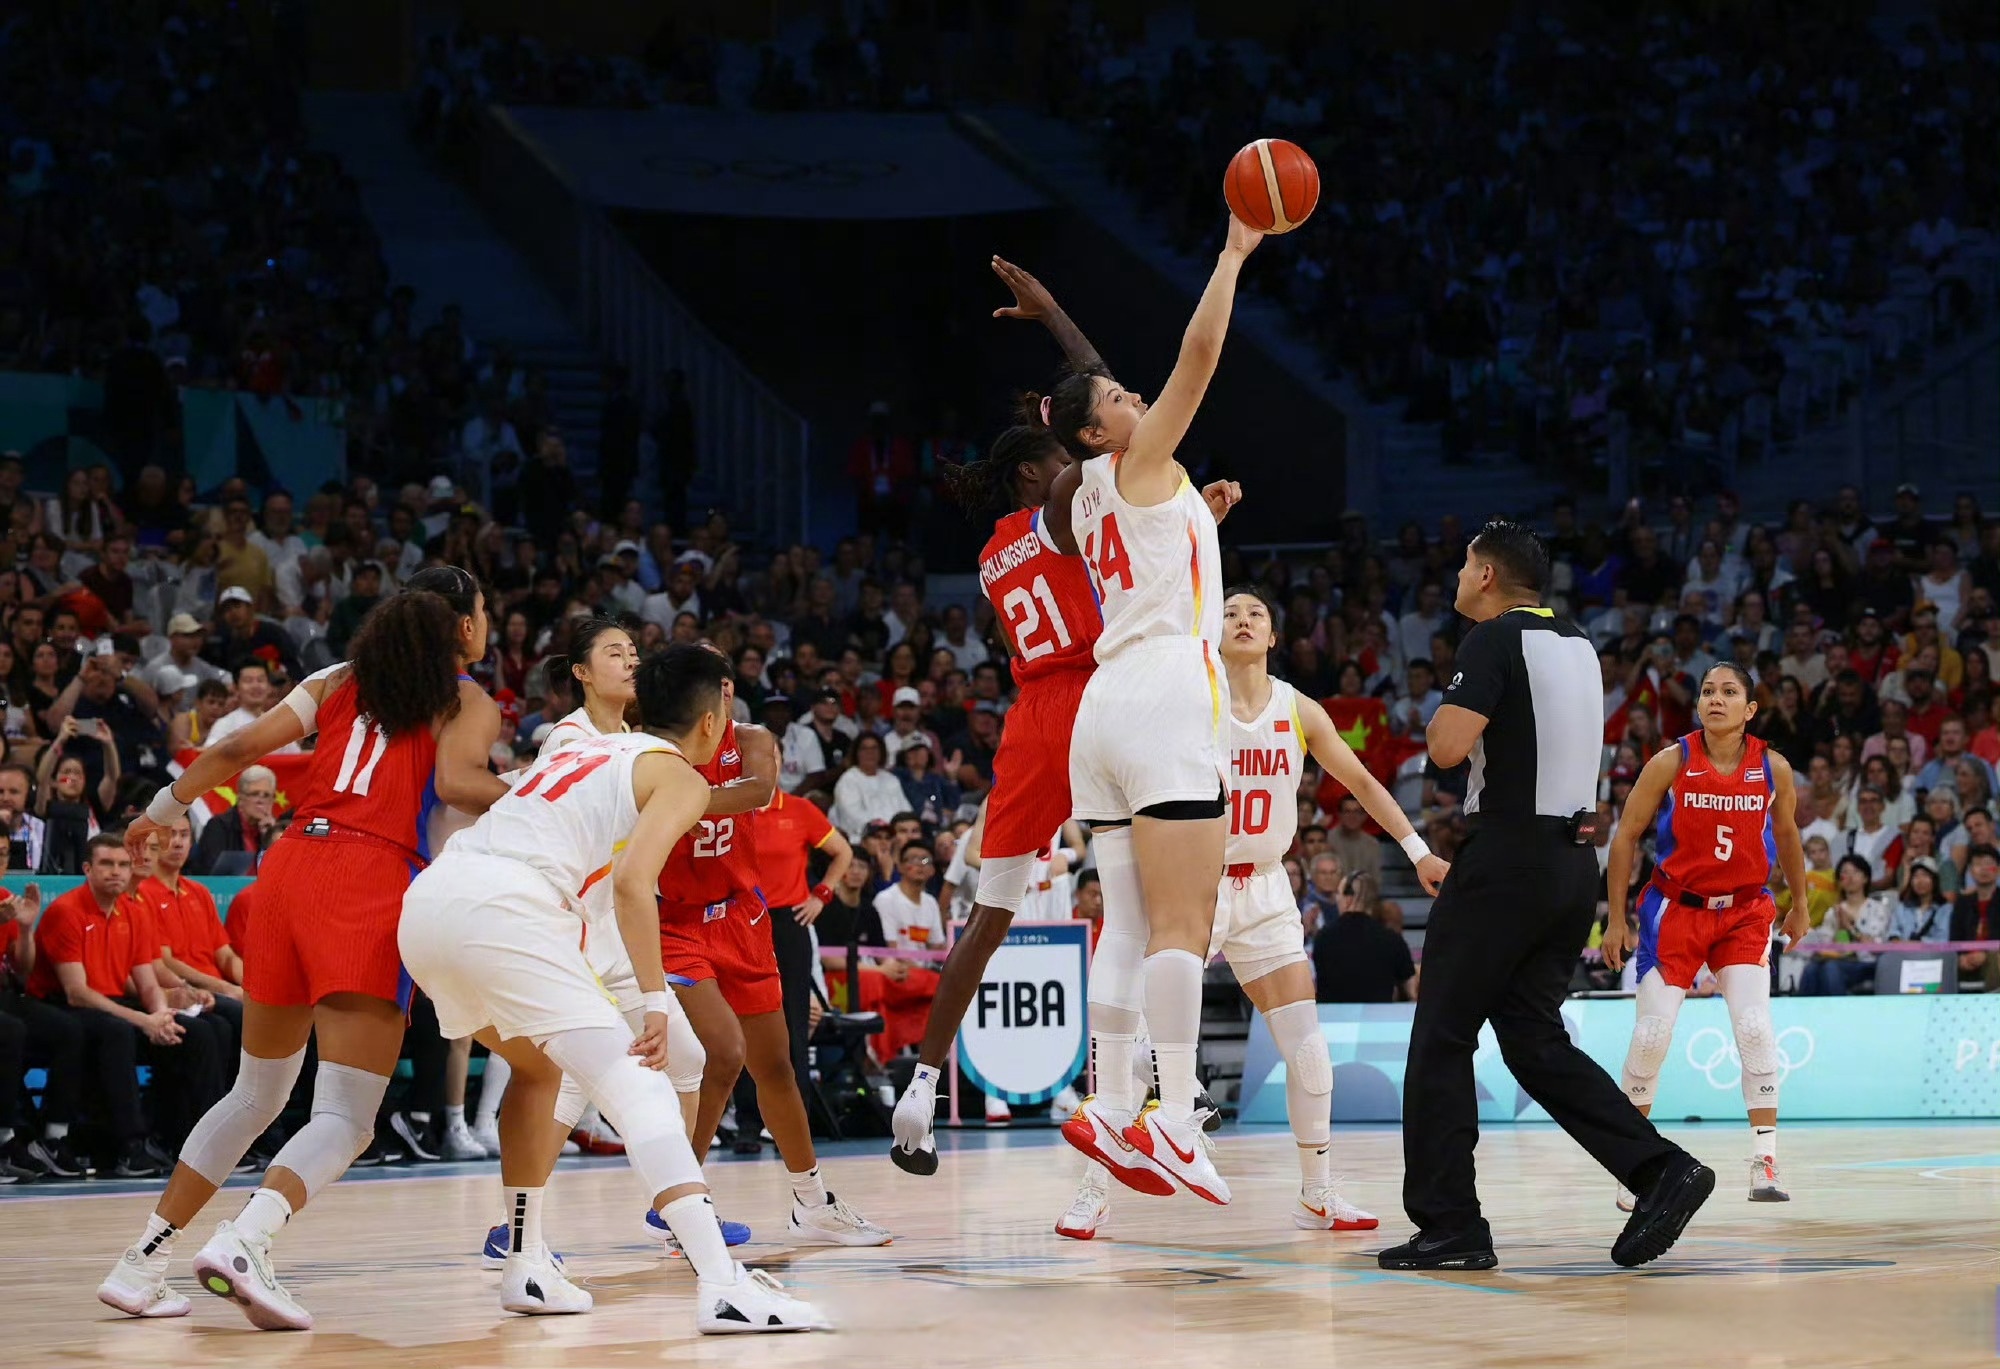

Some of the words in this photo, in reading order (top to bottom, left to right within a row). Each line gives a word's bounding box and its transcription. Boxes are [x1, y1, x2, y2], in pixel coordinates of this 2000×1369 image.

[980, 531, 1042, 586] HOLLINGSHED
[1003, 573, 1072, 663] 21
[333, 711, 391, 797] 11
[1231, 748, 1290, 776] HINA
[1230, 789, 1272, 835] 10
[1683, 792, 1732, 811] PUERTO
[1734, 794, 1765, 811] RICO
[693, 817, 734, 858] 22
[1714, 824, 1734, 862] 5
[978, 979, 1065, 1029] FIBA
